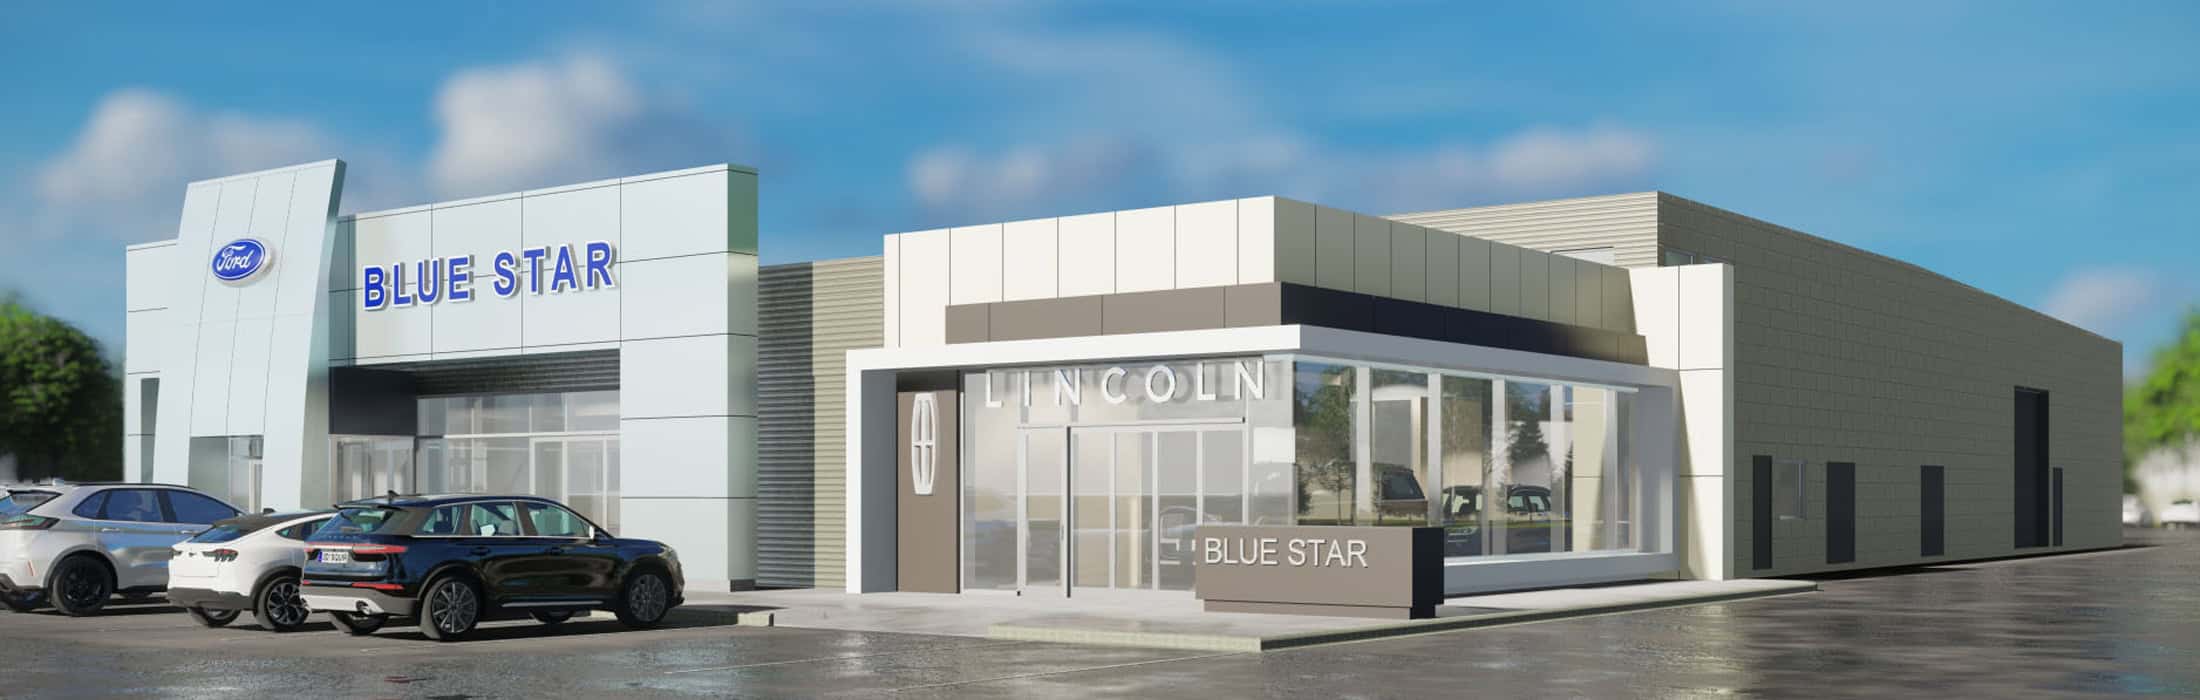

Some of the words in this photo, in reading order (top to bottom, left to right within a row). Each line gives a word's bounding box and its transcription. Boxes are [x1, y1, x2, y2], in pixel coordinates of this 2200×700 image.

[216, 245, 255, 272] Ford
[363, 256, 472, 311] BLUE
[492, 241, 615, 297] STAR
[985, 358, 1264, 408] LINCOLN
[1204, 537, 1279, 566] BLUE
[1287, 539, 1369, 568] STAR
